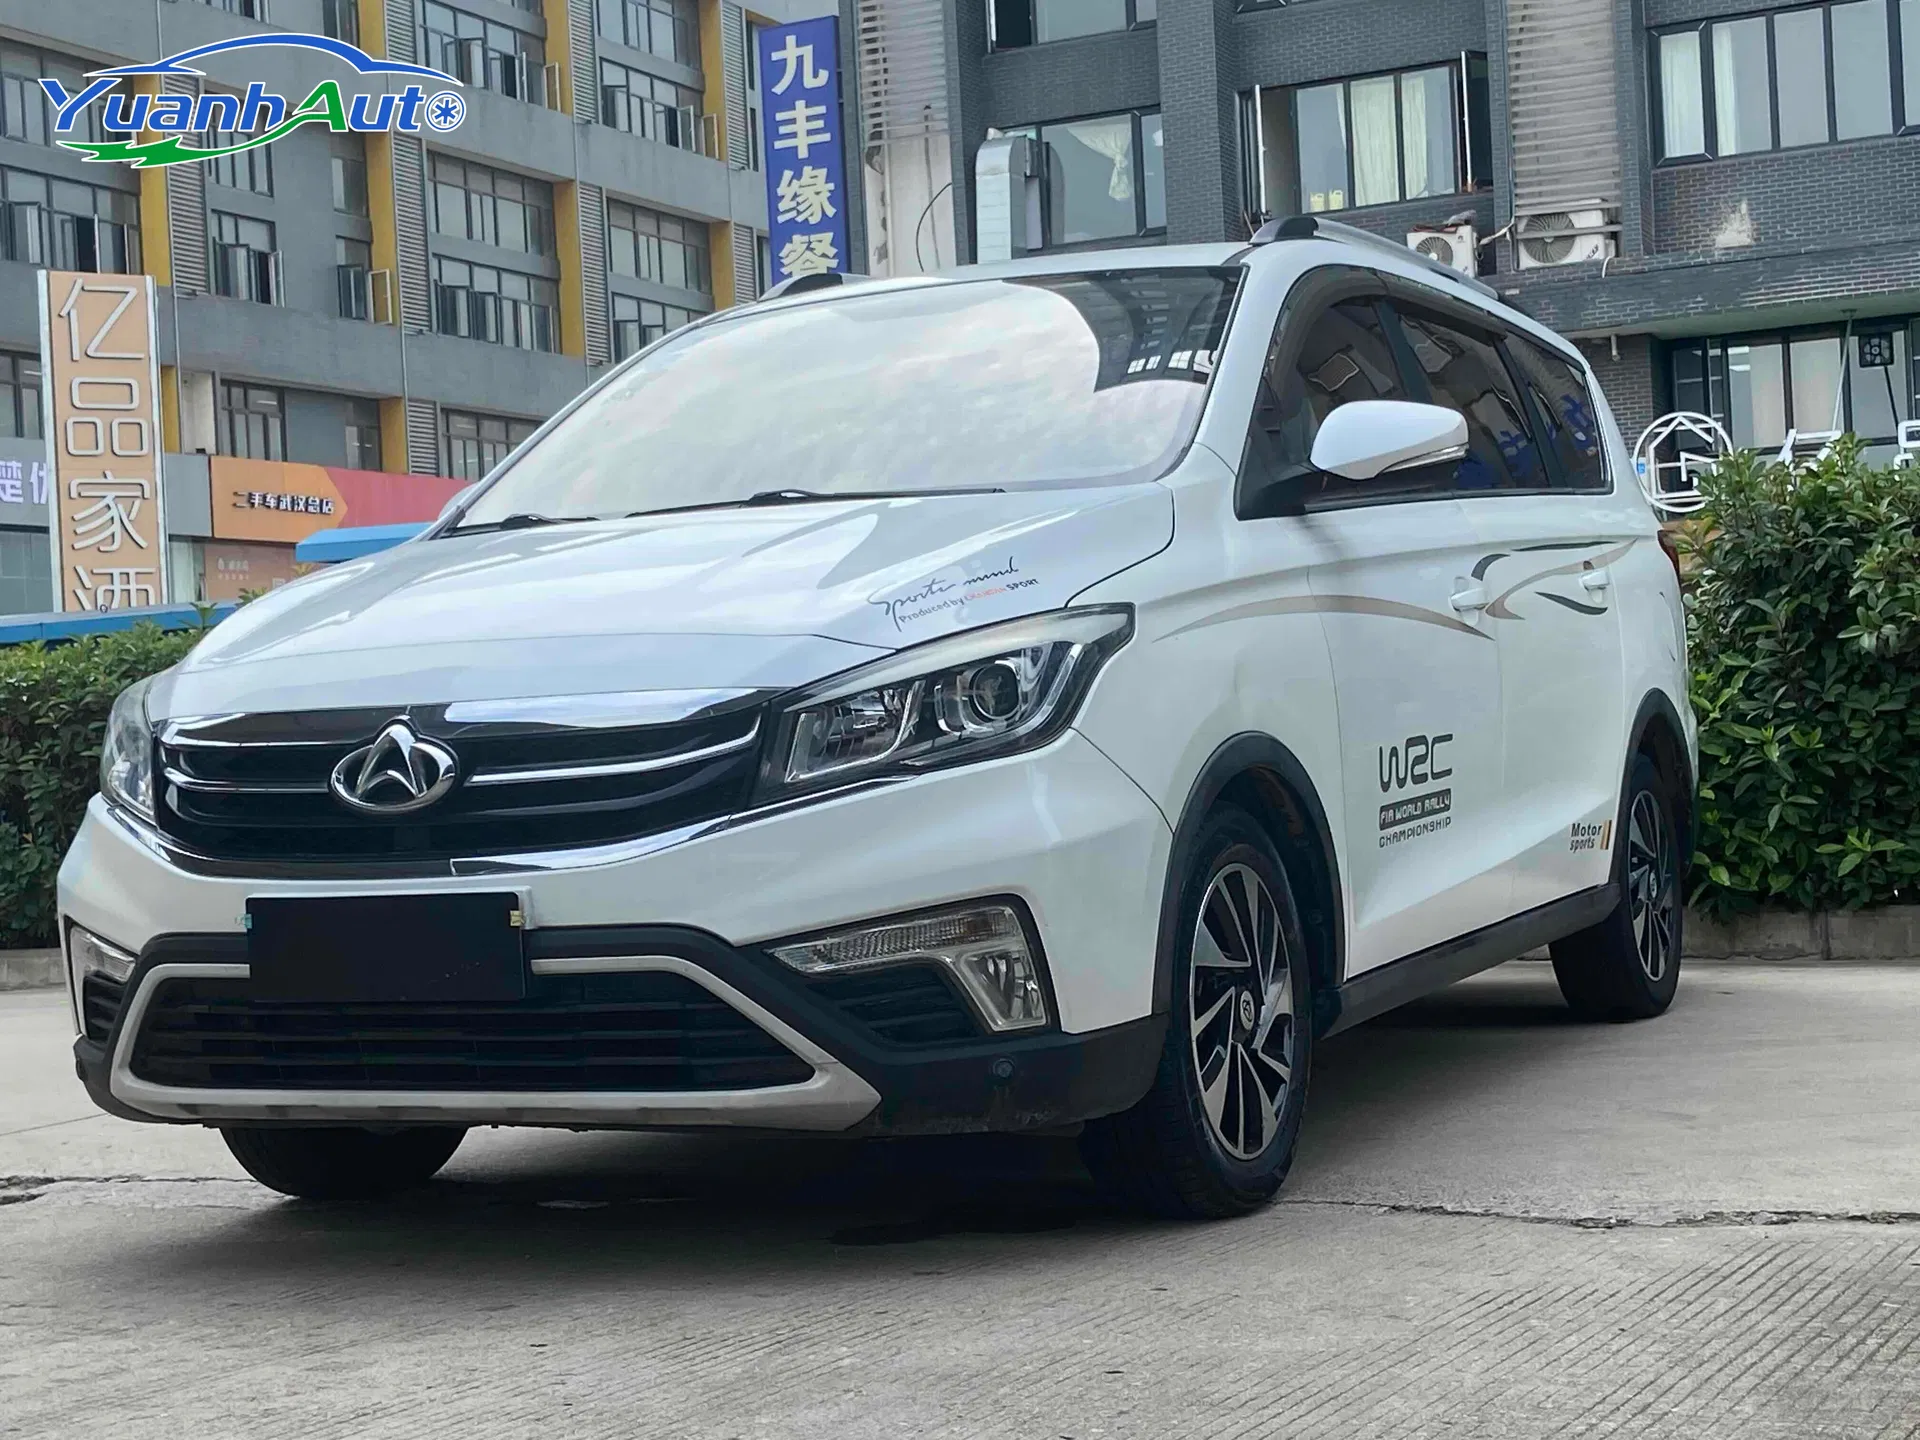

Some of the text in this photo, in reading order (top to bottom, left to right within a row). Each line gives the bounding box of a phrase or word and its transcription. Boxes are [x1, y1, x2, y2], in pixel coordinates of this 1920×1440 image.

[232, 491, 334, 516] 二手车武汉总店
[898, 577, 1040, 624] Produced by SPORT
[1379, 733, 1453, 793] WRC
[1381, 794, 1450, 825] FIA WORLD RALLY
[1379, 816, 1451, 848] CHAMPIONSHIP
[1570, 837, 1595, 854] sports
[1571, 822, 1602, 838] Motor
